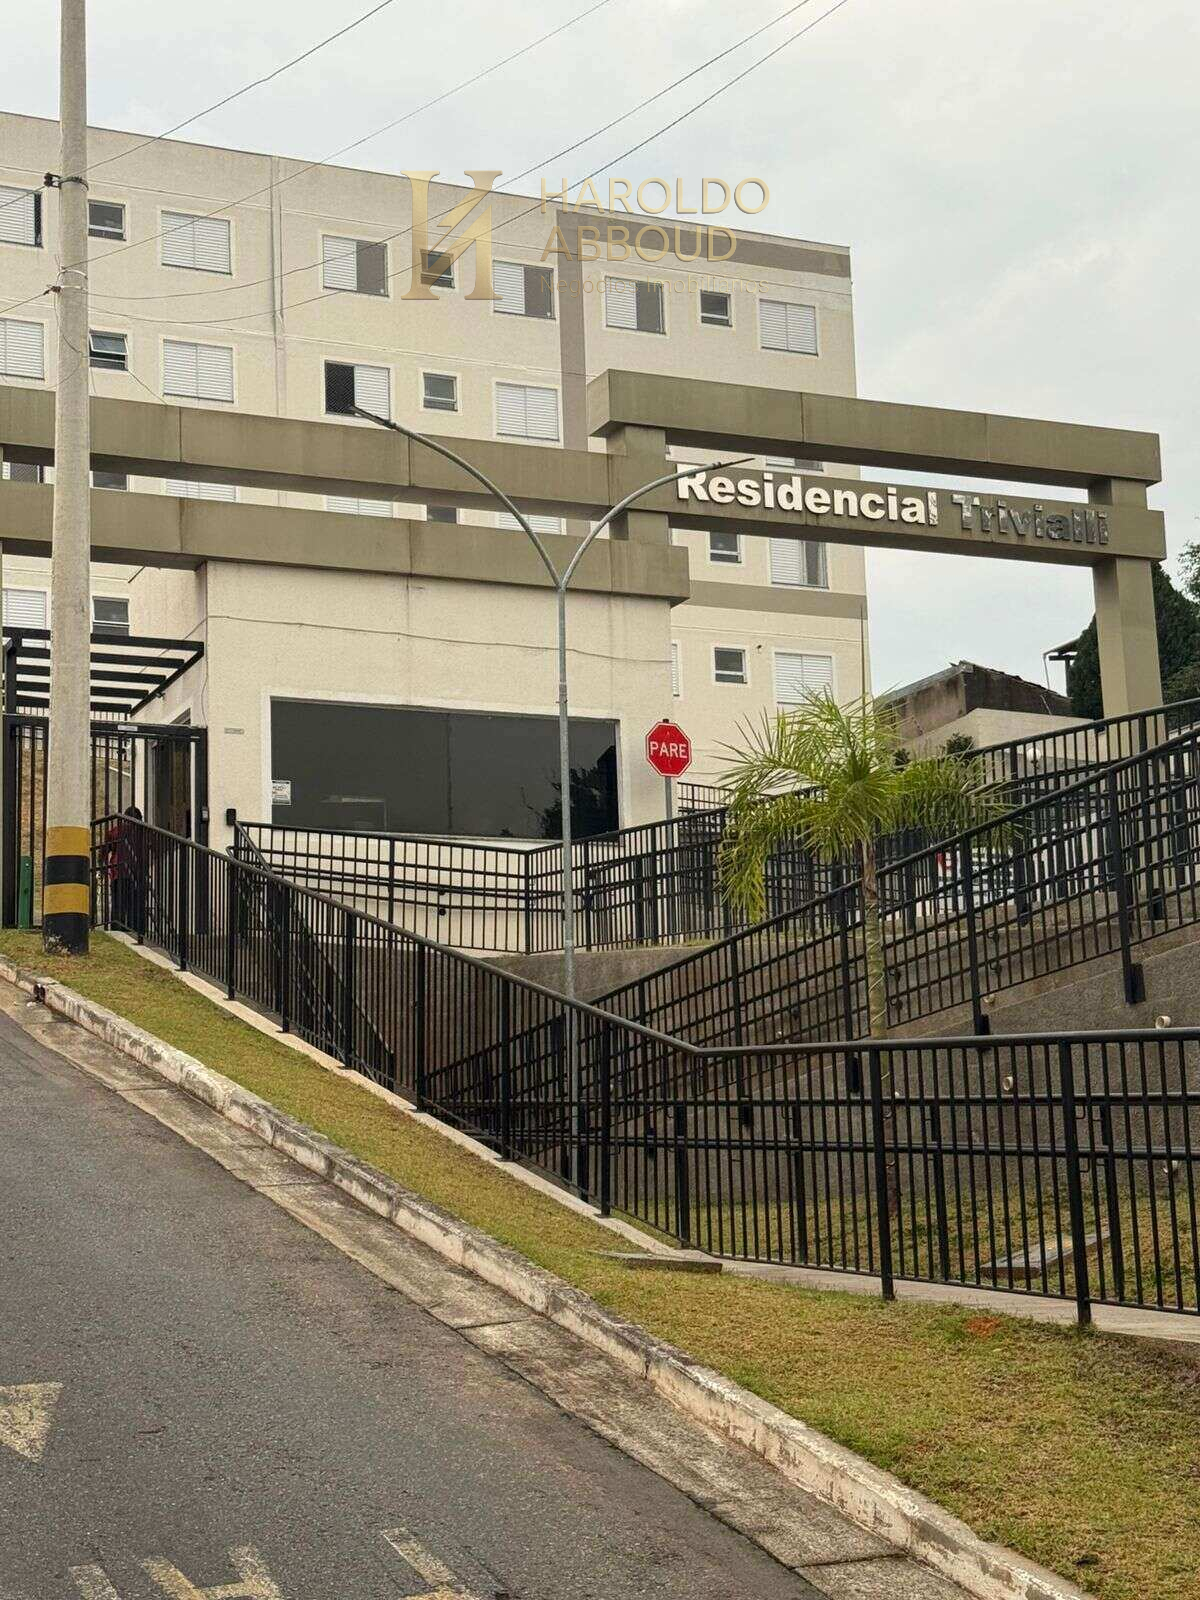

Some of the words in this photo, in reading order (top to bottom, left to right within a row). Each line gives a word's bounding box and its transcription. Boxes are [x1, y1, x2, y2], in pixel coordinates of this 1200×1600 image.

[676, 464, 938, 527] Residencial
[952, 493, 1109, 545] Trivialli
[649, 741, 688, 759] PARE
